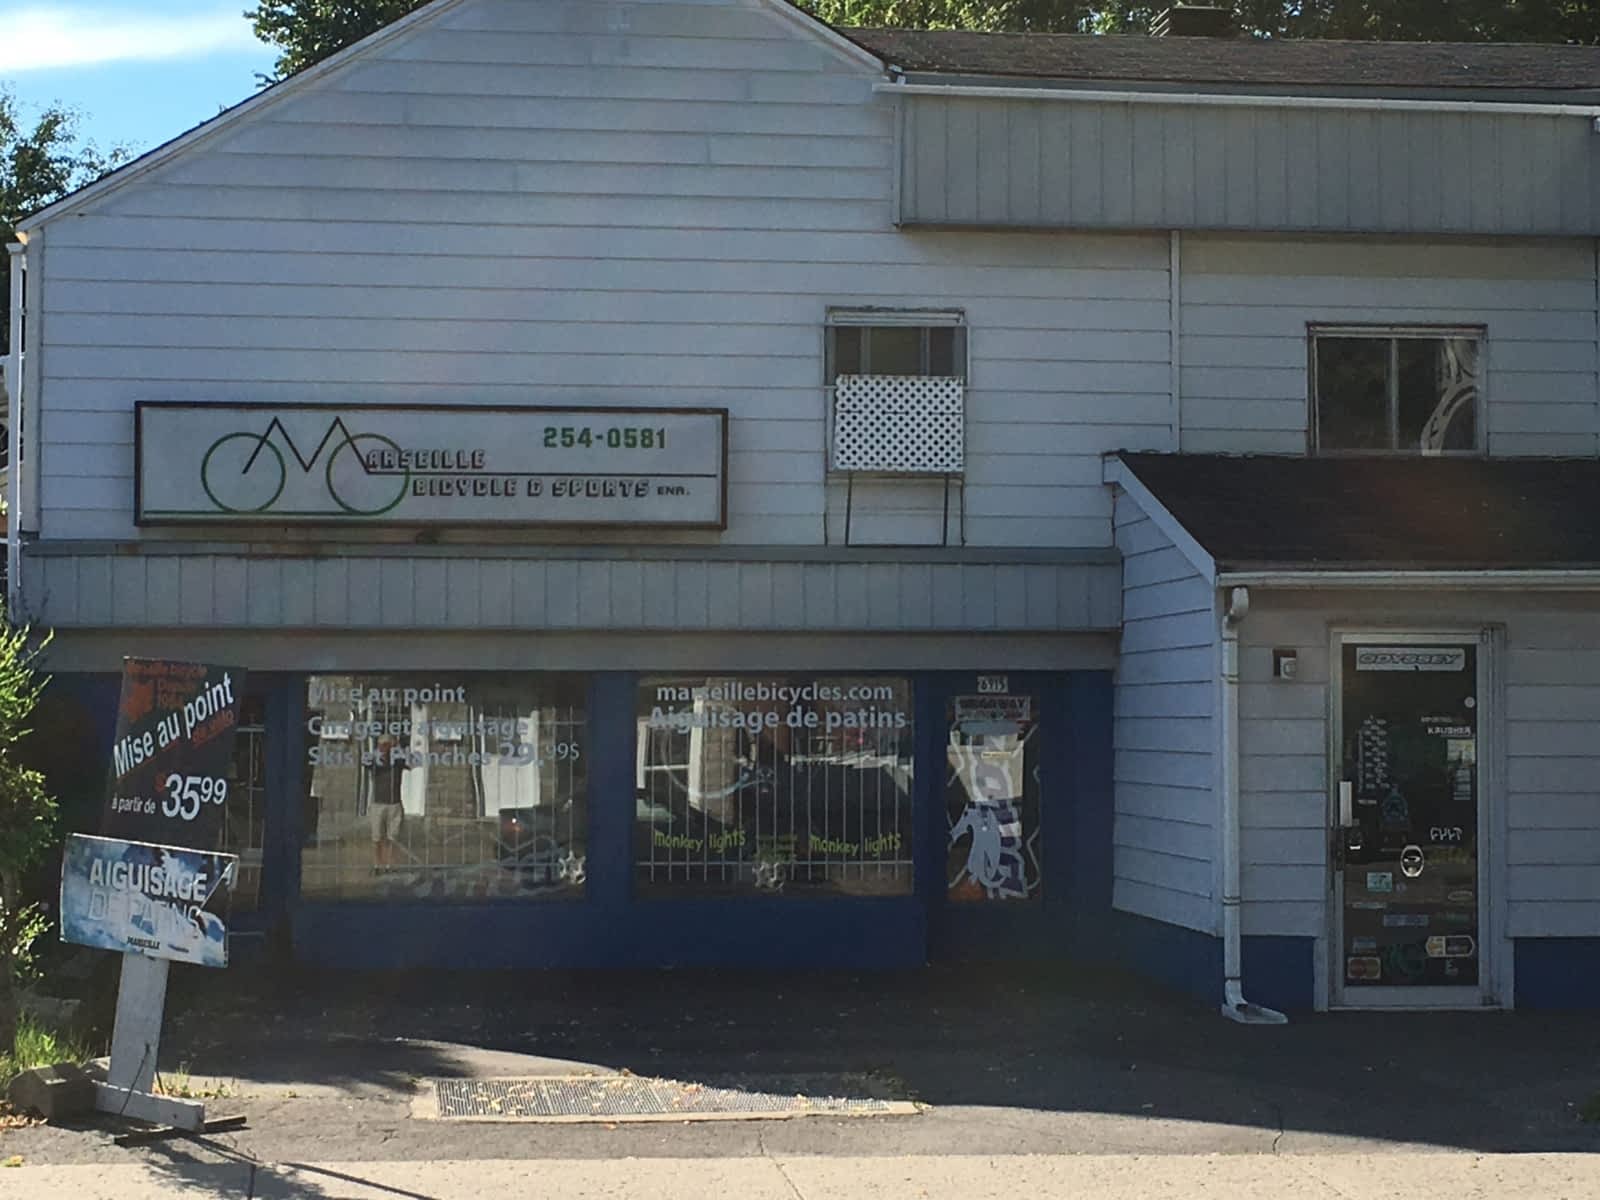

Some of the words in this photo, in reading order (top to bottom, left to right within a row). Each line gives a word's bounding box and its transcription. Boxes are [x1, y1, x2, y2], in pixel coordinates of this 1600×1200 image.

[543, 427, 666, 449] 254-0581
[413, 478, 517, 497] BICYCLE
[552, 479, 650, 498] SPORTS
[1359, 653, 1462, 665] ODYSSEY
[404, 682, 466, 708] point
[656, 682, 893, 705] marseillebicycles.com
[113, 731, 155, 778] Mise
[157, 712, 181, 747] au
[183, 672, 234, 739] point
[389, 719, 411, 736] et
[648, 706, 780, 734] Aiguisage
[786, 707, 819, 728] de
[826, 706, 907, 733] patins
[118, 797, 142, 813] partir
[144, 797, 156, 814] de
[655, 829, 703, 853] monkey
[709, 830, 745, 854] lights
[809, 834, 859, 857] monkey
[865, 832, 901, 857] lights
[90, 858, 207, 902] AIGUISAGE
